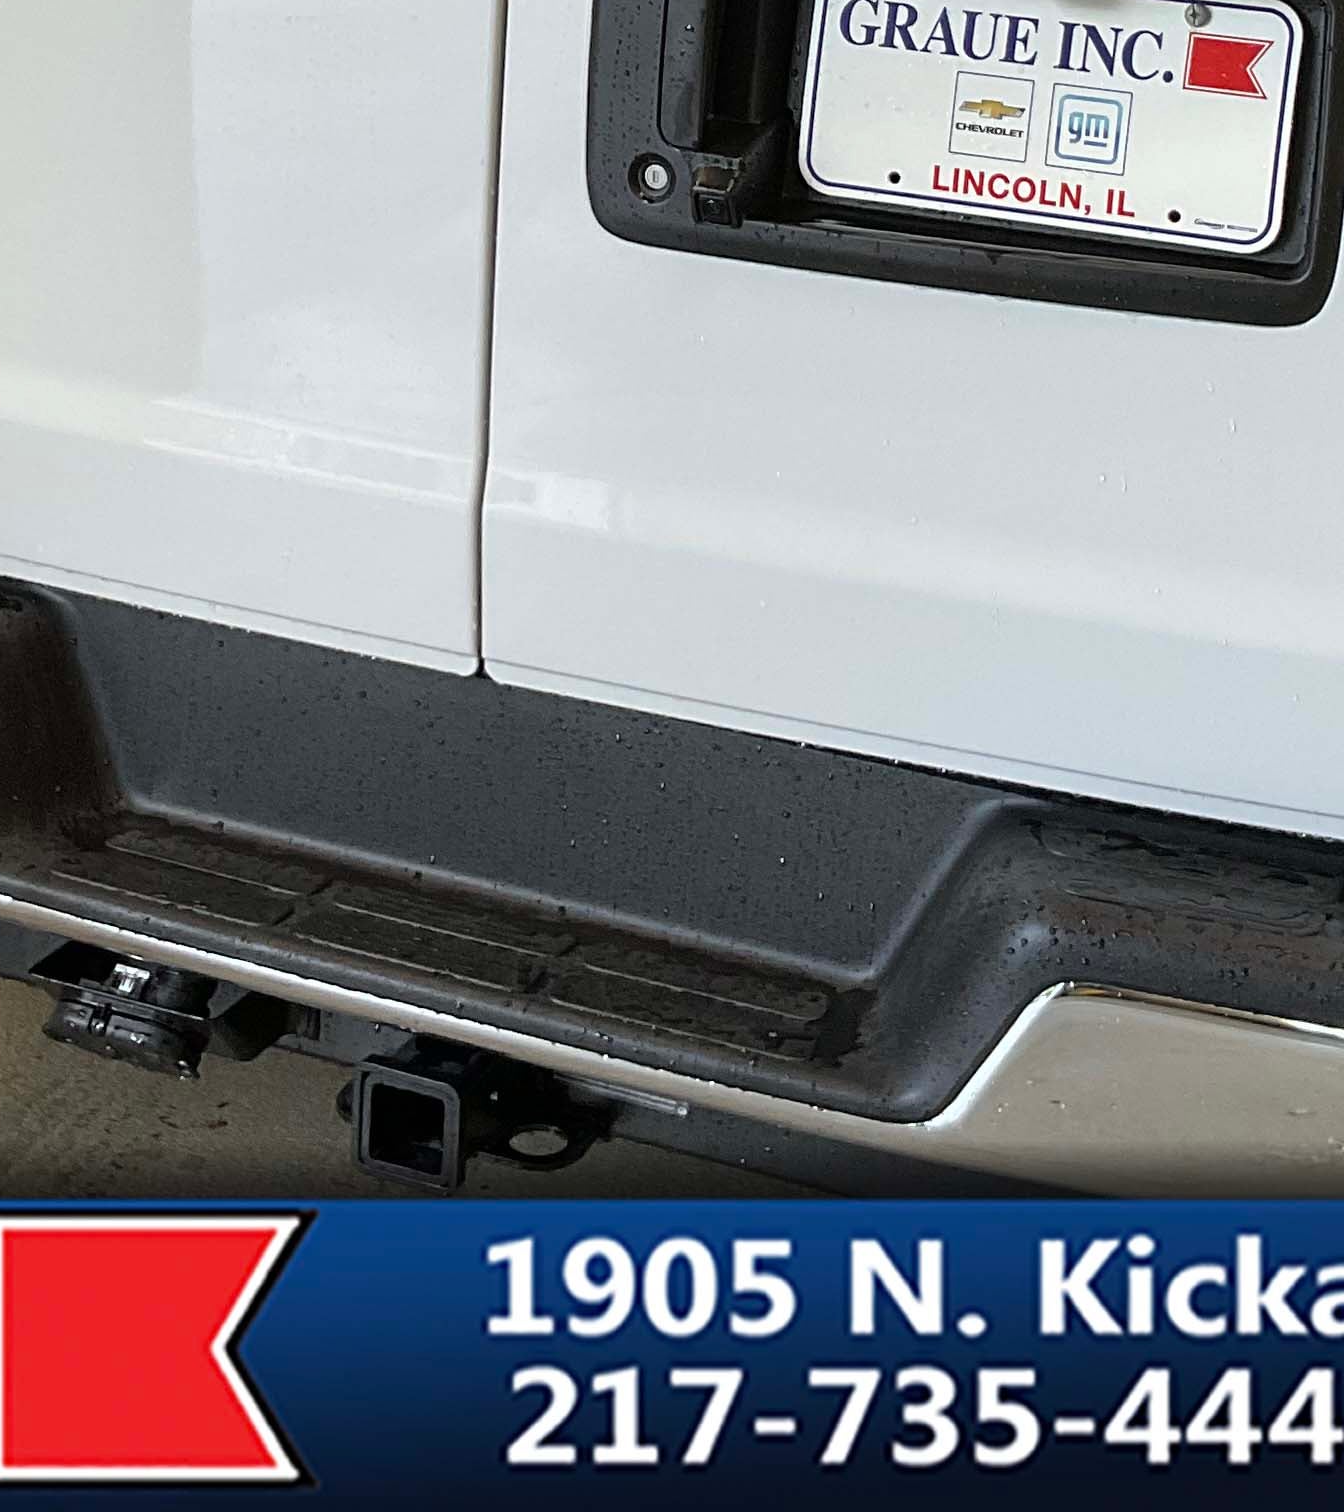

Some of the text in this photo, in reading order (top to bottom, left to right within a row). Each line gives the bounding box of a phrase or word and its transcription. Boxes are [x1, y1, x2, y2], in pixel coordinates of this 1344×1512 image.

[1052, 20, 1174, 84] INC.
[955, 121, 1025, 139] CHEVROLET
[1067, 110, 1110, 148] gm
[931, 164, 1136, 218] LINCOLN, IL
